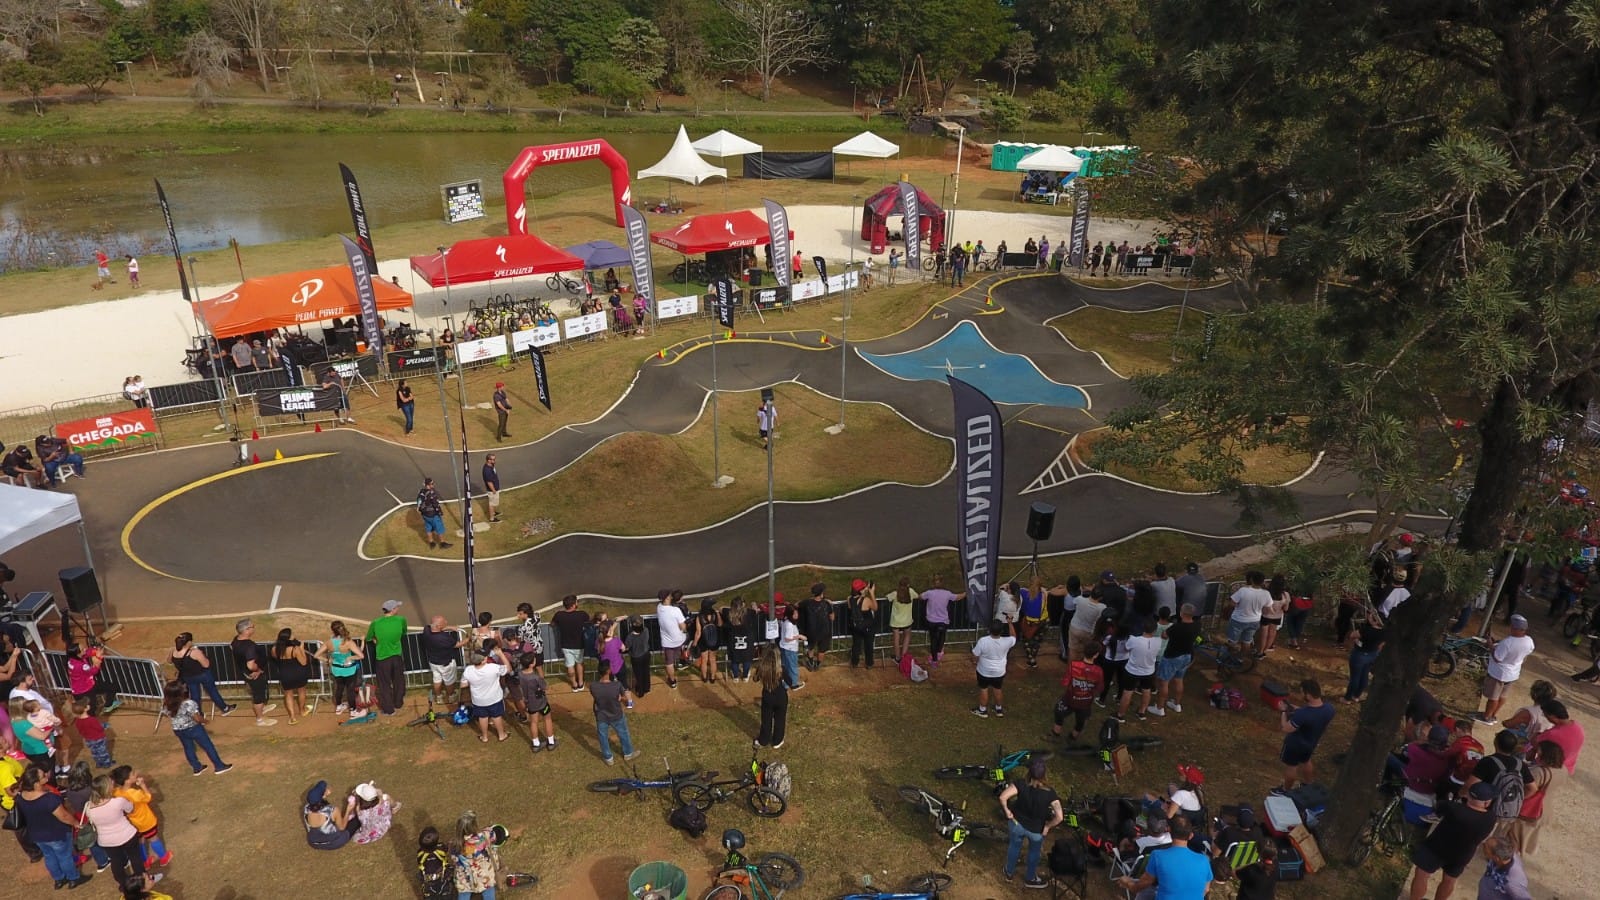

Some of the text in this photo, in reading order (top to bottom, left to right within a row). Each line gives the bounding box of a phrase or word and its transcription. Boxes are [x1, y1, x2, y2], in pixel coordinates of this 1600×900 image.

[542, 143, 600, 163] SPECIALIZED
[348, 182, 368, 239] PEDAL POWER
[494, 266, 534, 278] SPECIALIZED
[295, 310, 316, 321] PEDAL
[280, 391, 315, 404] PUMP
[281, 400, 317, 412] LEAGUE
[69, 422, 146, 445] CHEGADA
